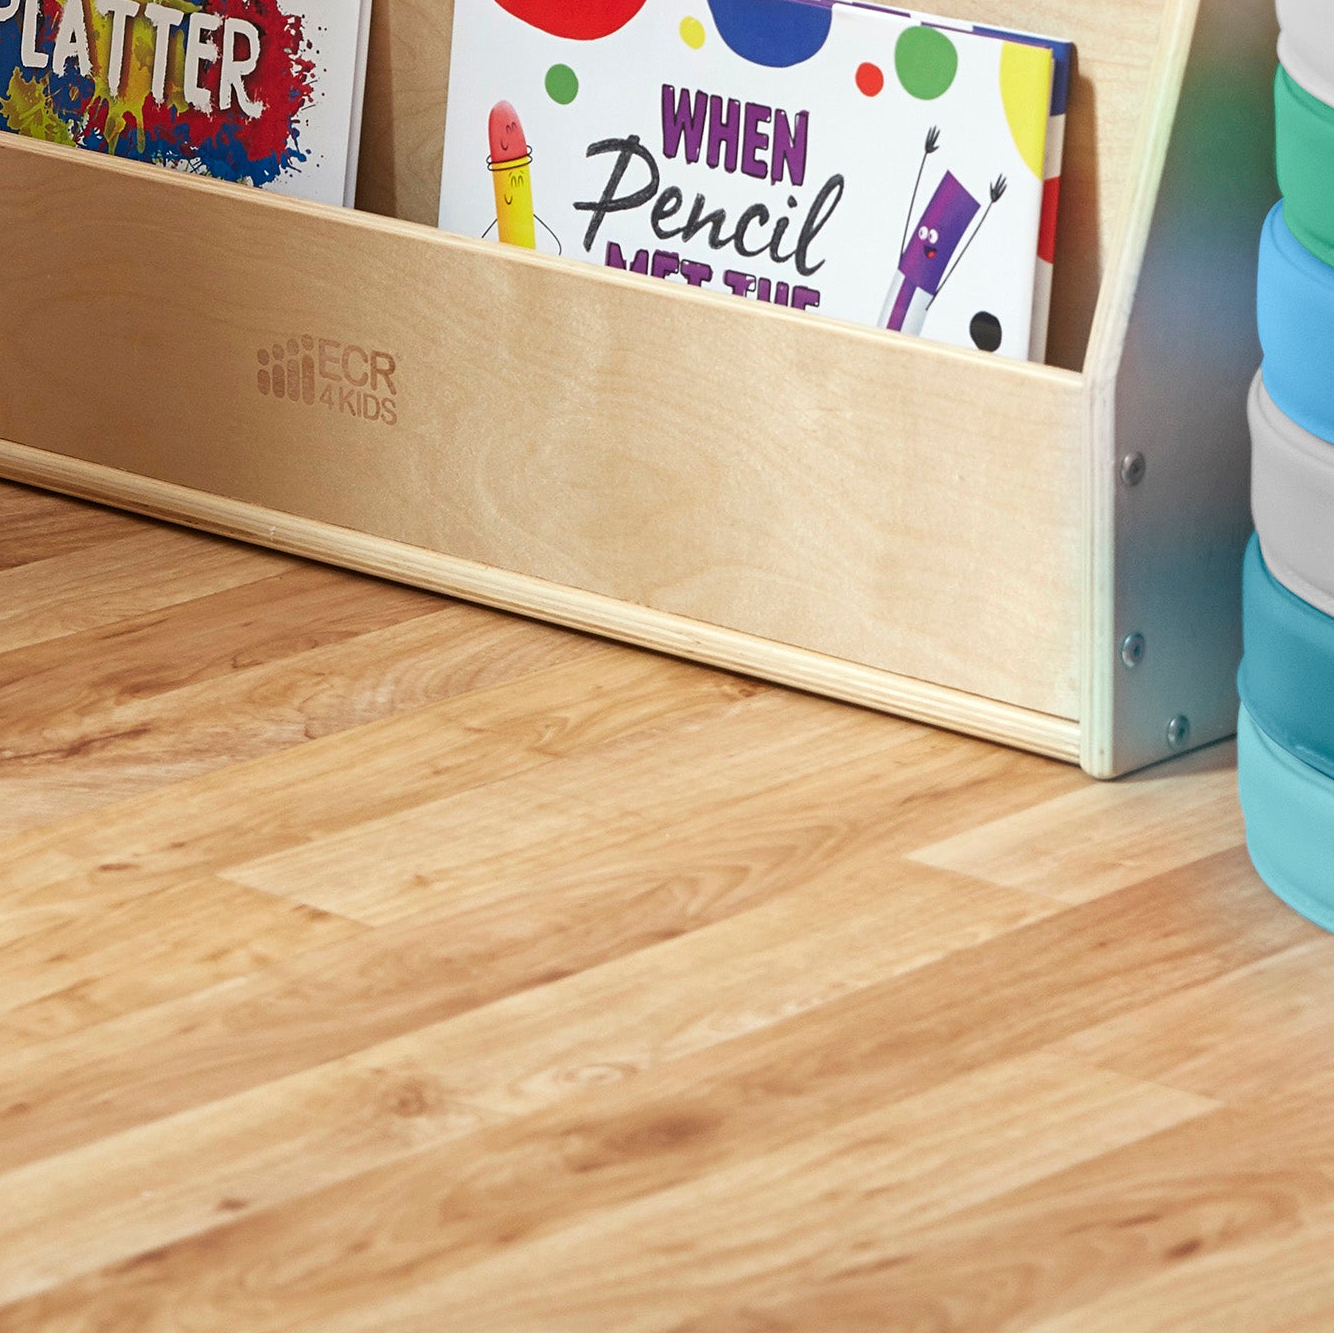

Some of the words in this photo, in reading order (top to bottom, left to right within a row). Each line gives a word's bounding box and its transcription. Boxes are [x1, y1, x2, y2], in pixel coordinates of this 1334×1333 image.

[660, 83, 810, 187] WHEN
[572, 134, 845, 277] Pencil
[318, 338, 397, 396] ECR
